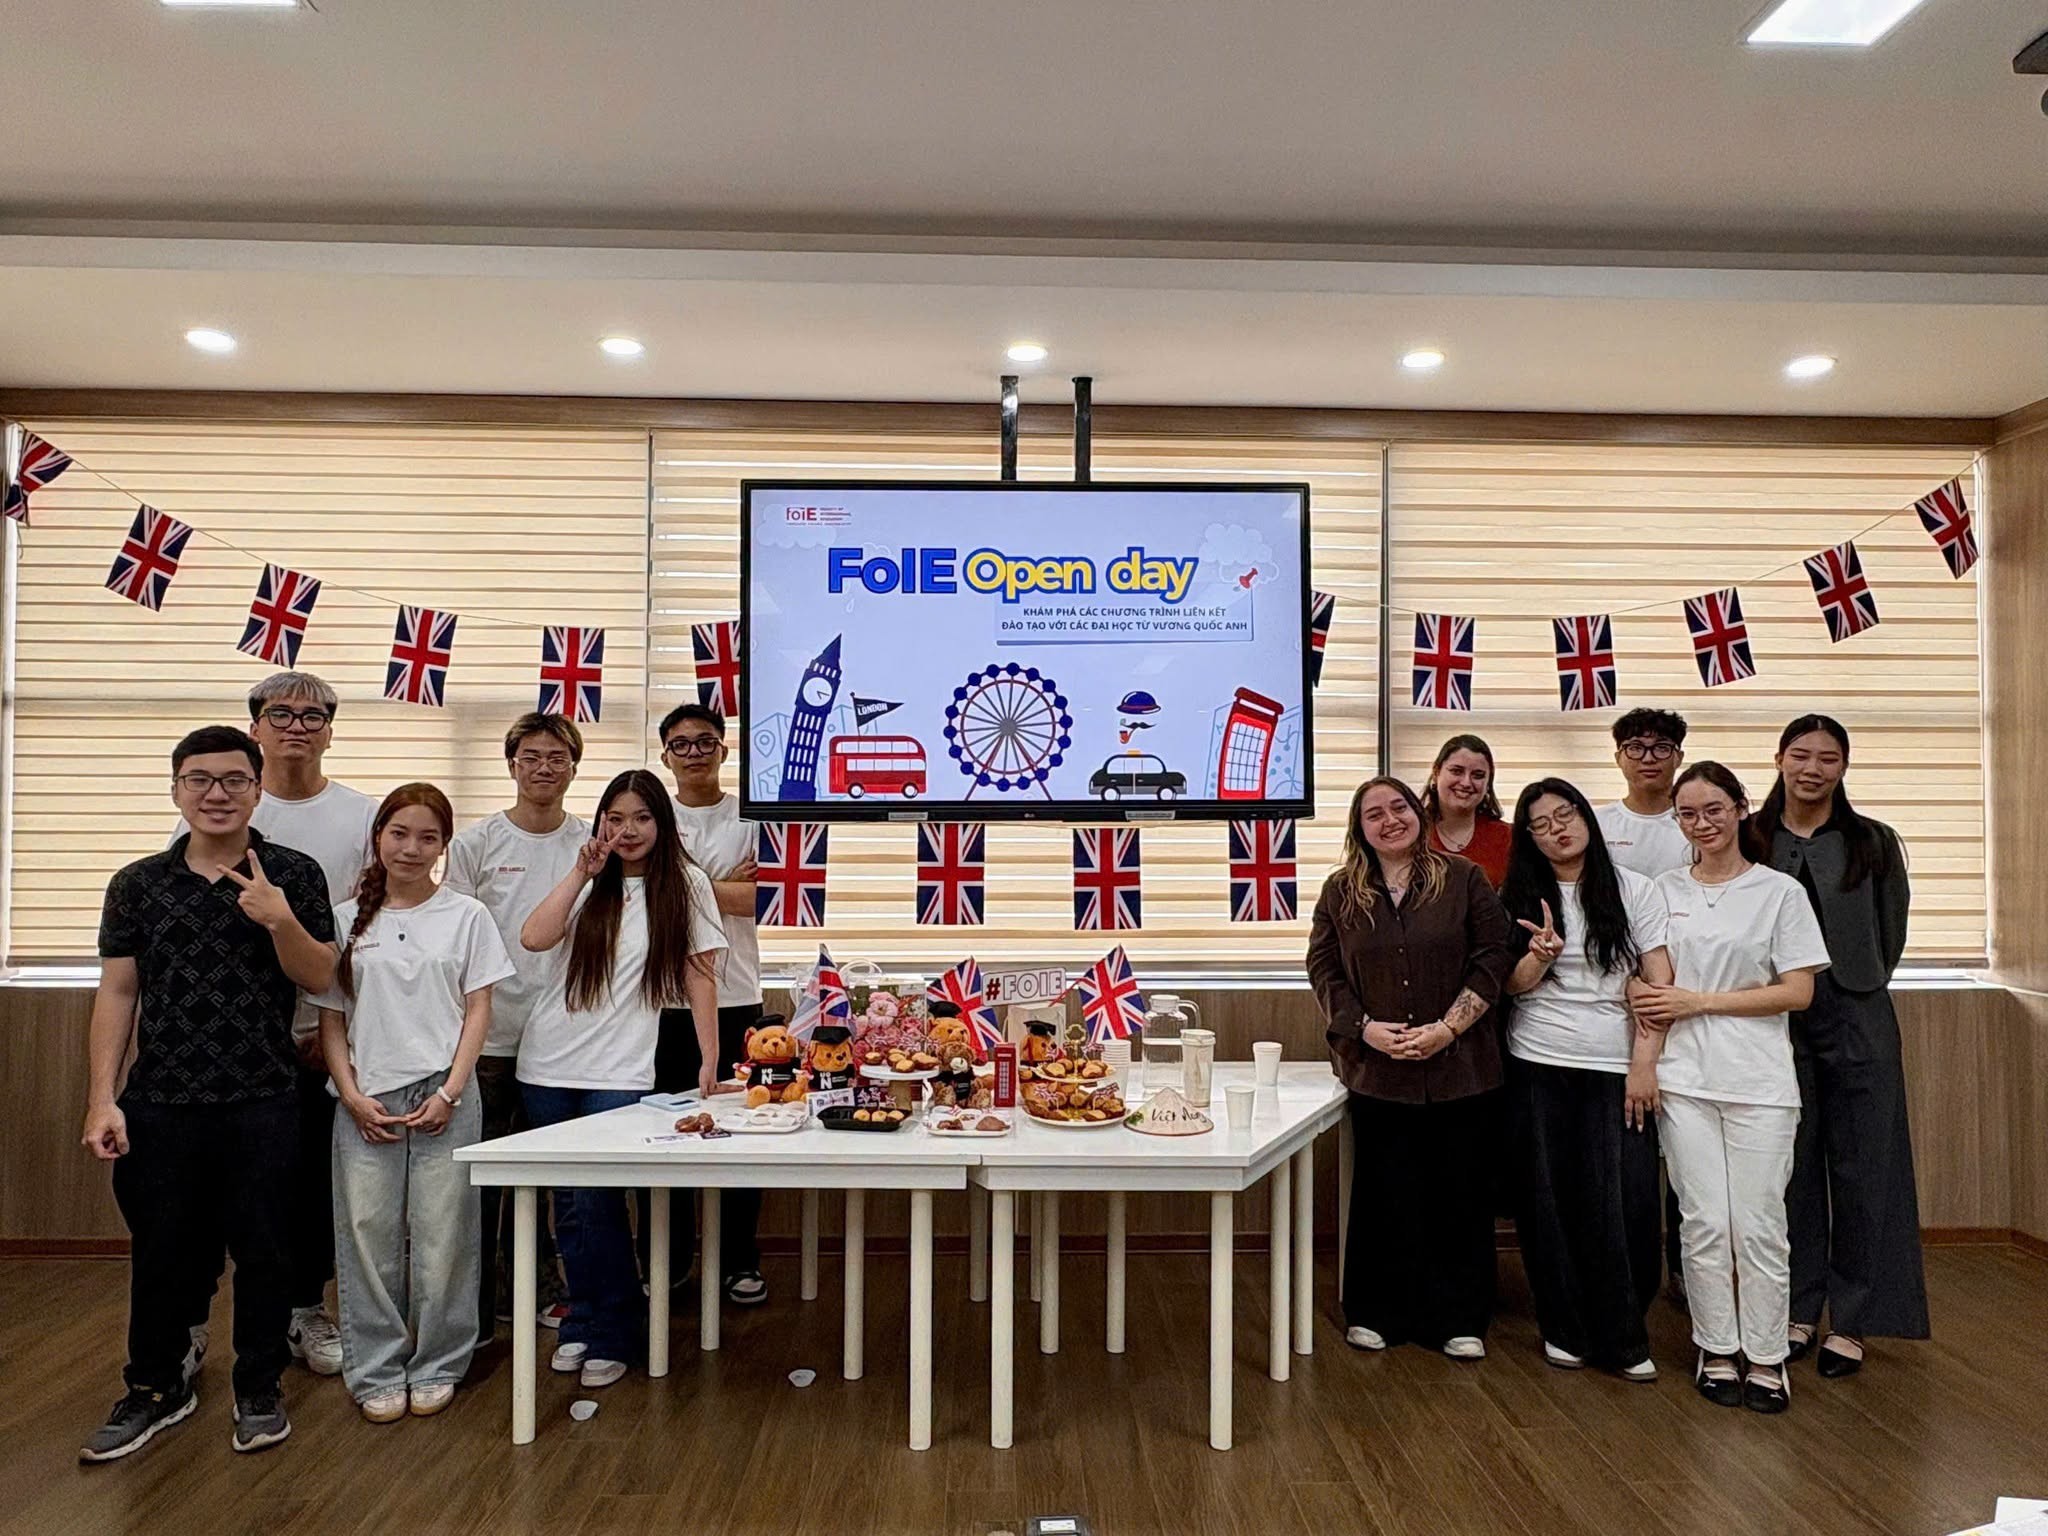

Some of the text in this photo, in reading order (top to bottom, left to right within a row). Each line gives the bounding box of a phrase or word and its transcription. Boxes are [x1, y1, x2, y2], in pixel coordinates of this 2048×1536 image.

[963, 548, 1097, 603] Open
[1106, 546, 1199, 604] day
[1023, 606, 1053, 616] KHÁM
[1056, 606, 1077, 616] PHÁ
[1079, 606, 1099, 616] CÁC
[1101, 607, 1146, 616] CHƯƠNG
[1149, 606, 1180, 616] TRÌNH
[1183, 606, 1206, 616] LIÊN
[1001, 619, 1247, 632] ĐÀO TẠO VỚI CÁC ĐẠI HỌC TỪ VƯƠNG QUỐC ANH
[857, 703, 888, 716] LONDON
[985, 970, 1062, 1000] #FOIE
